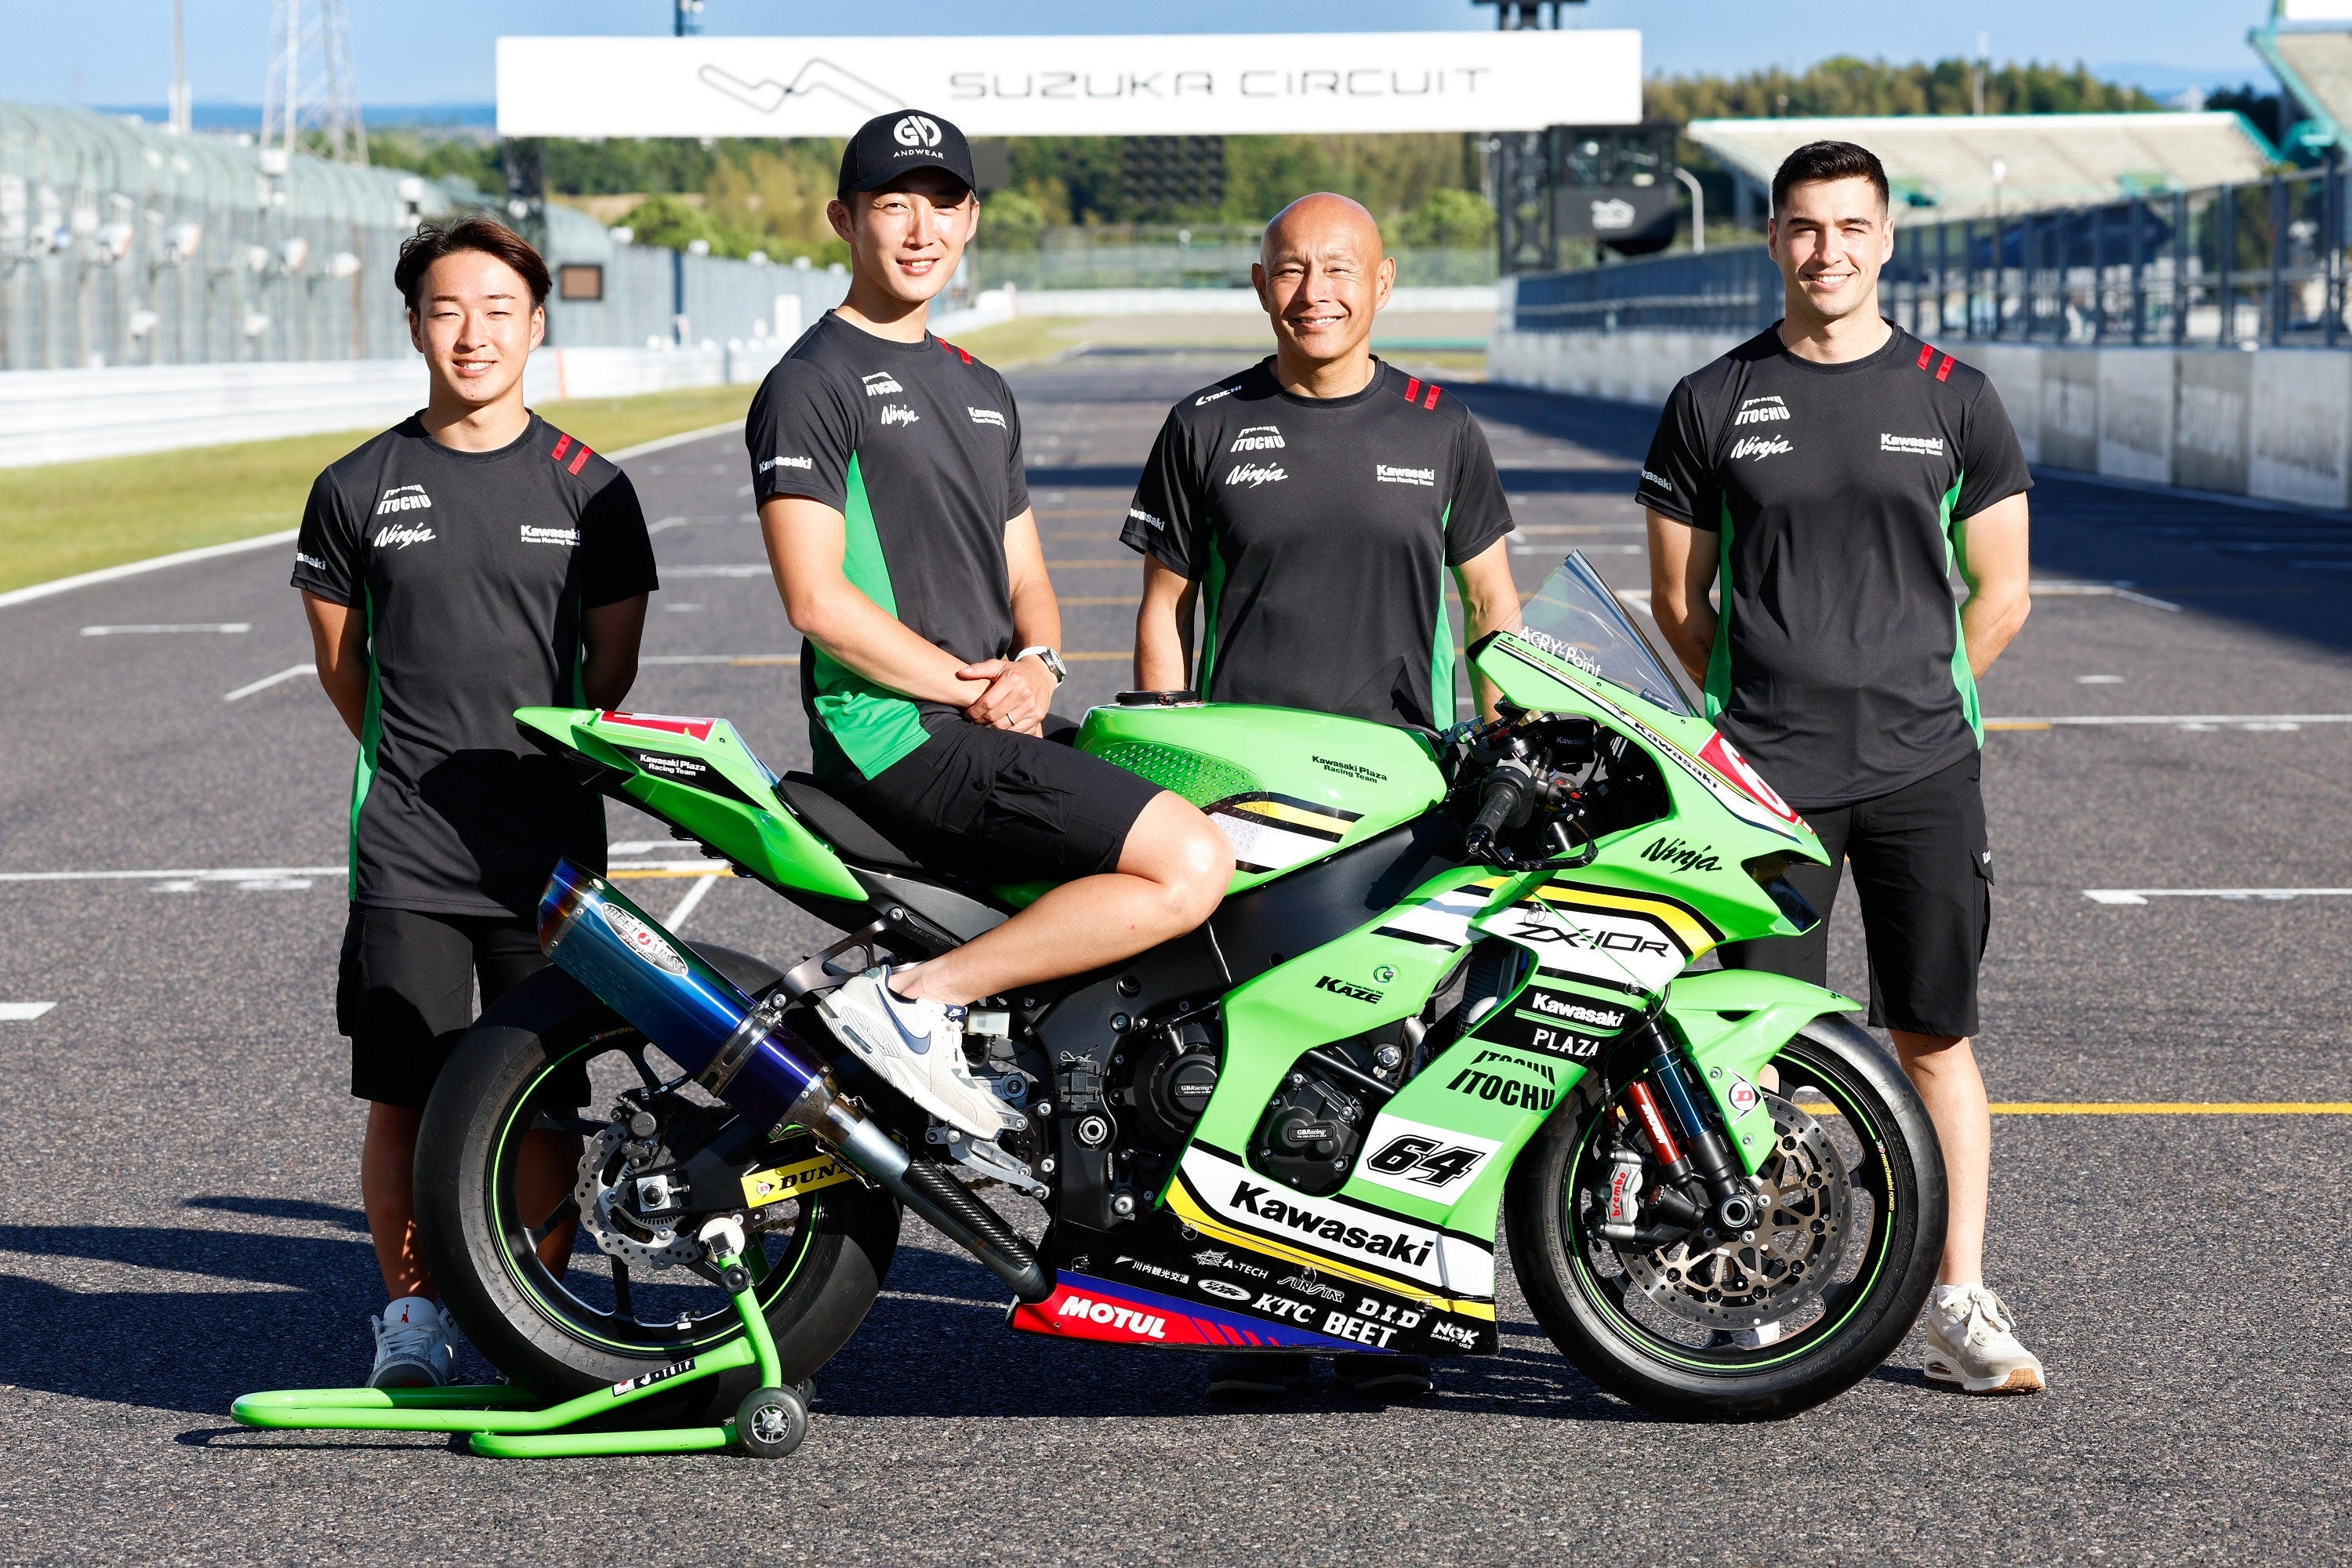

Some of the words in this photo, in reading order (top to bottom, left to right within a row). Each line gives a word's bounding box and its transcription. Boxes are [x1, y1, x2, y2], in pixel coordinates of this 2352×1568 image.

[950, 71, 1212, 99] SUZUKA
[1241, 67, 1490, 96] CIRCUIT
[893, 148, 944, 160] ANDWEAR
[880, 403, 920, 427] Ninja
[1734, 406, 1791, 426] ITOCHU
[1230, 434, 1286, 452] ITOCHU
[1730, 434, 1794, 462] Ninja
[1881, 433, 1944, 450] Kawasaki
[759, 456, 811, 474] Kawasaki
[1225, 462, 1289, 488] Ninja
[1377, 464, 1435, 481] Kawasaki
[376, 494, 432, 515] ITOCHU
[373, 521, 436, 550] Ninja
[521, 524, 580, 540] Kawasaki
[296, 548, 326, 571] asaki
[640, 753, 680, 768] Kawasaki
[680, 760, 706, 771] Plaza
[1312, 755, 1358, 772] Kawasaki
[1359, 766, 1388, 781] Plaza
[1635, 720, 1719, 789] Kawasaki
[648, 763, 675, 774] Racing
[675, 767, 696, 776] Team
[1323, 764, 1354, 778] Racing
[1355, 772, 1377, 783] Team
[1640, 837, 1723, 874] Ninja
[1507, 921, 1669, 958] ZX-10R
[1315, 975, 1383, 1004] KAZE
[1532, 992, 1625, 1028] Kawasaki
[1532, 1028, 1600, 1058] PLAZA
[1446, 1068, 1556, 1111] ITOCHU
[1640, 1103, 1670, 1144] SHOWA
[1366, 1134, 1487, 1187] 64
[1880, 1153, 1895, 1191] marchesini
[1611, 1172, 1626, 1218] brembo
[1229, 1180, 1437, 1268] Kawasaki
[1132, 1260, 1190, 1284] 川内観光交通
[1221, 1258, 1269, 1279] A-TECH
[1276, 1276, 1345, 1304] SUNSTAR
[1058, 1294, 1166, 1339] MOTUL
[1252, 1292, 1316, 1323] KTC
[1356, 1296, 1421, 1329] D.I.D
[1323, 1310, 1399, 1349] BEET
[1430, 1333, 1451, 1342] SPARK
[1432, 1319, 1480, 1345] NGK
